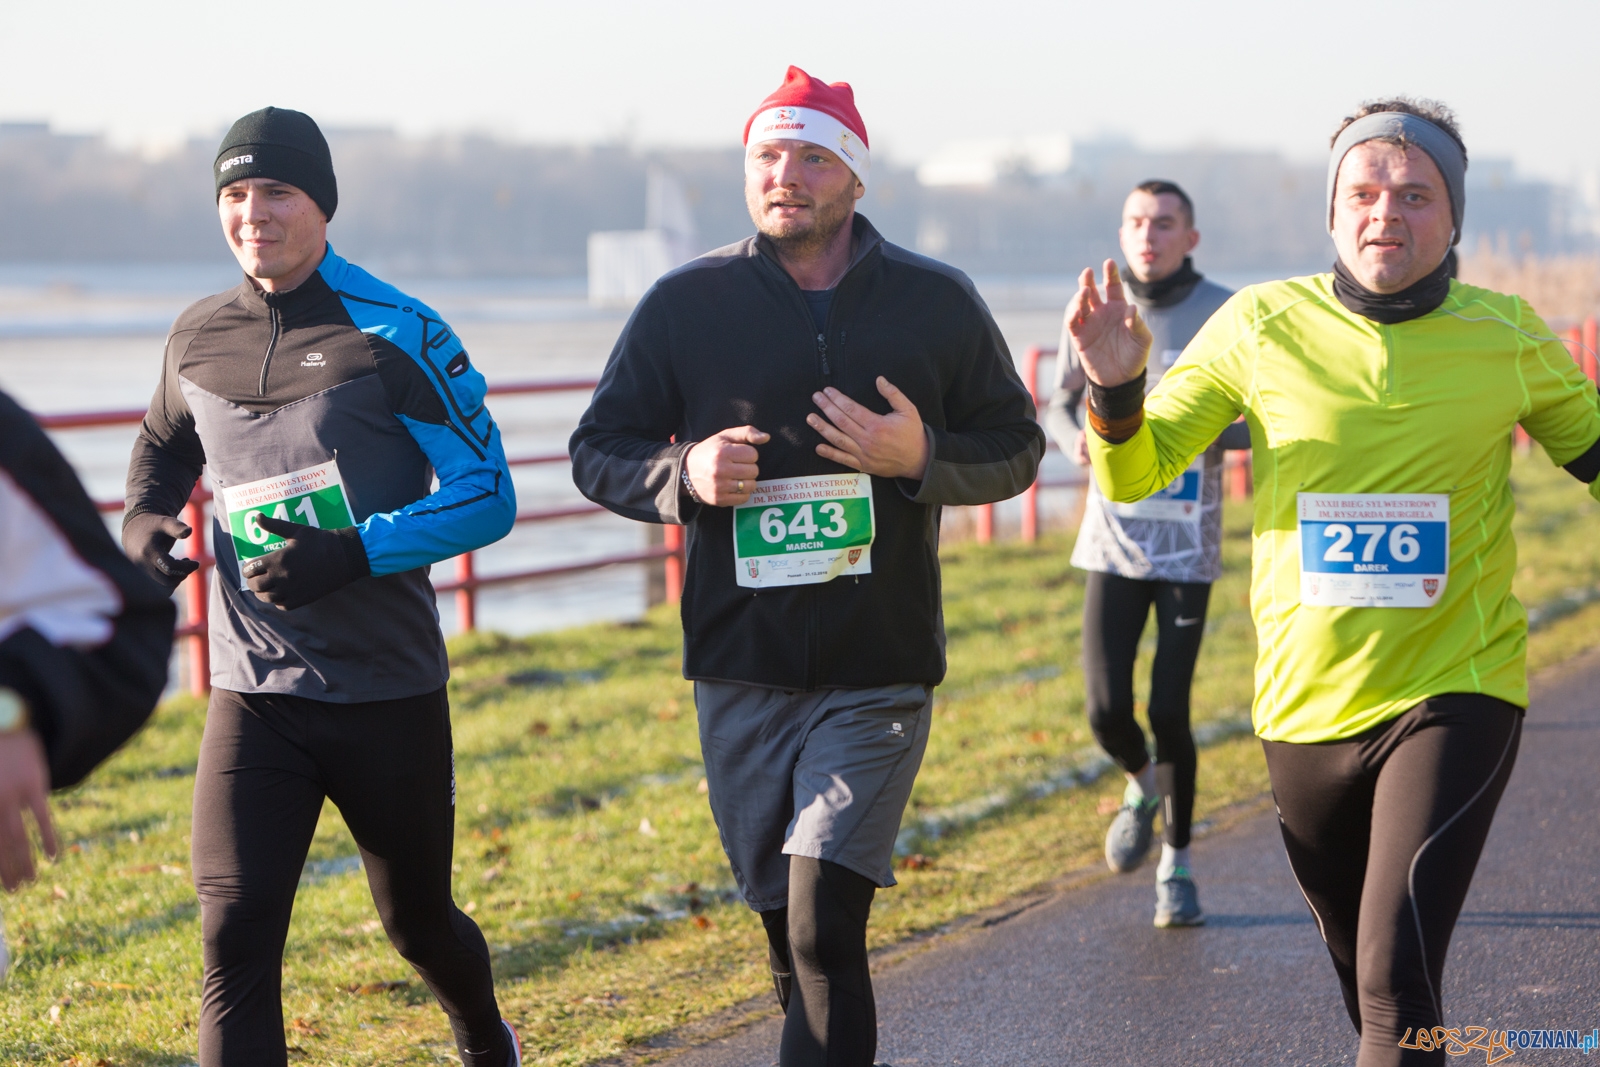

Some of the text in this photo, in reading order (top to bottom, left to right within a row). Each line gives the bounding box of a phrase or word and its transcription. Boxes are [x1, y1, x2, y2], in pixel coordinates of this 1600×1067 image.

[248, 486, 266, 496] BIEG
[266, 469, 327, 491] SYLWESTROWY
[772, 483, 793, 493] BIEG
[794, 479, 859, 490] SYLWESTROWY
[245, 491, 284, 506] RYSZARDA
[284, 479, 327, 497] BURGIELA
[753, 489, 857, 504] IM. RYSZARDA BURGIELA
[1314, 500, 1339, 508] XXXII
[1341, 500, 1364, 508] BIEG
[1366, 500, 1438, 508] SYLWESTROWY
[1334, 511, 1384, 519] RYSZARDA
[1386, 511, 1434, 519] BURGIELA
[759, 502, 848, 544] 643
[785, 541, 824, 552] MARCIN
[1322, 523, 1421, 563] 276
[1353, 563, 1389, 573] DAREK
